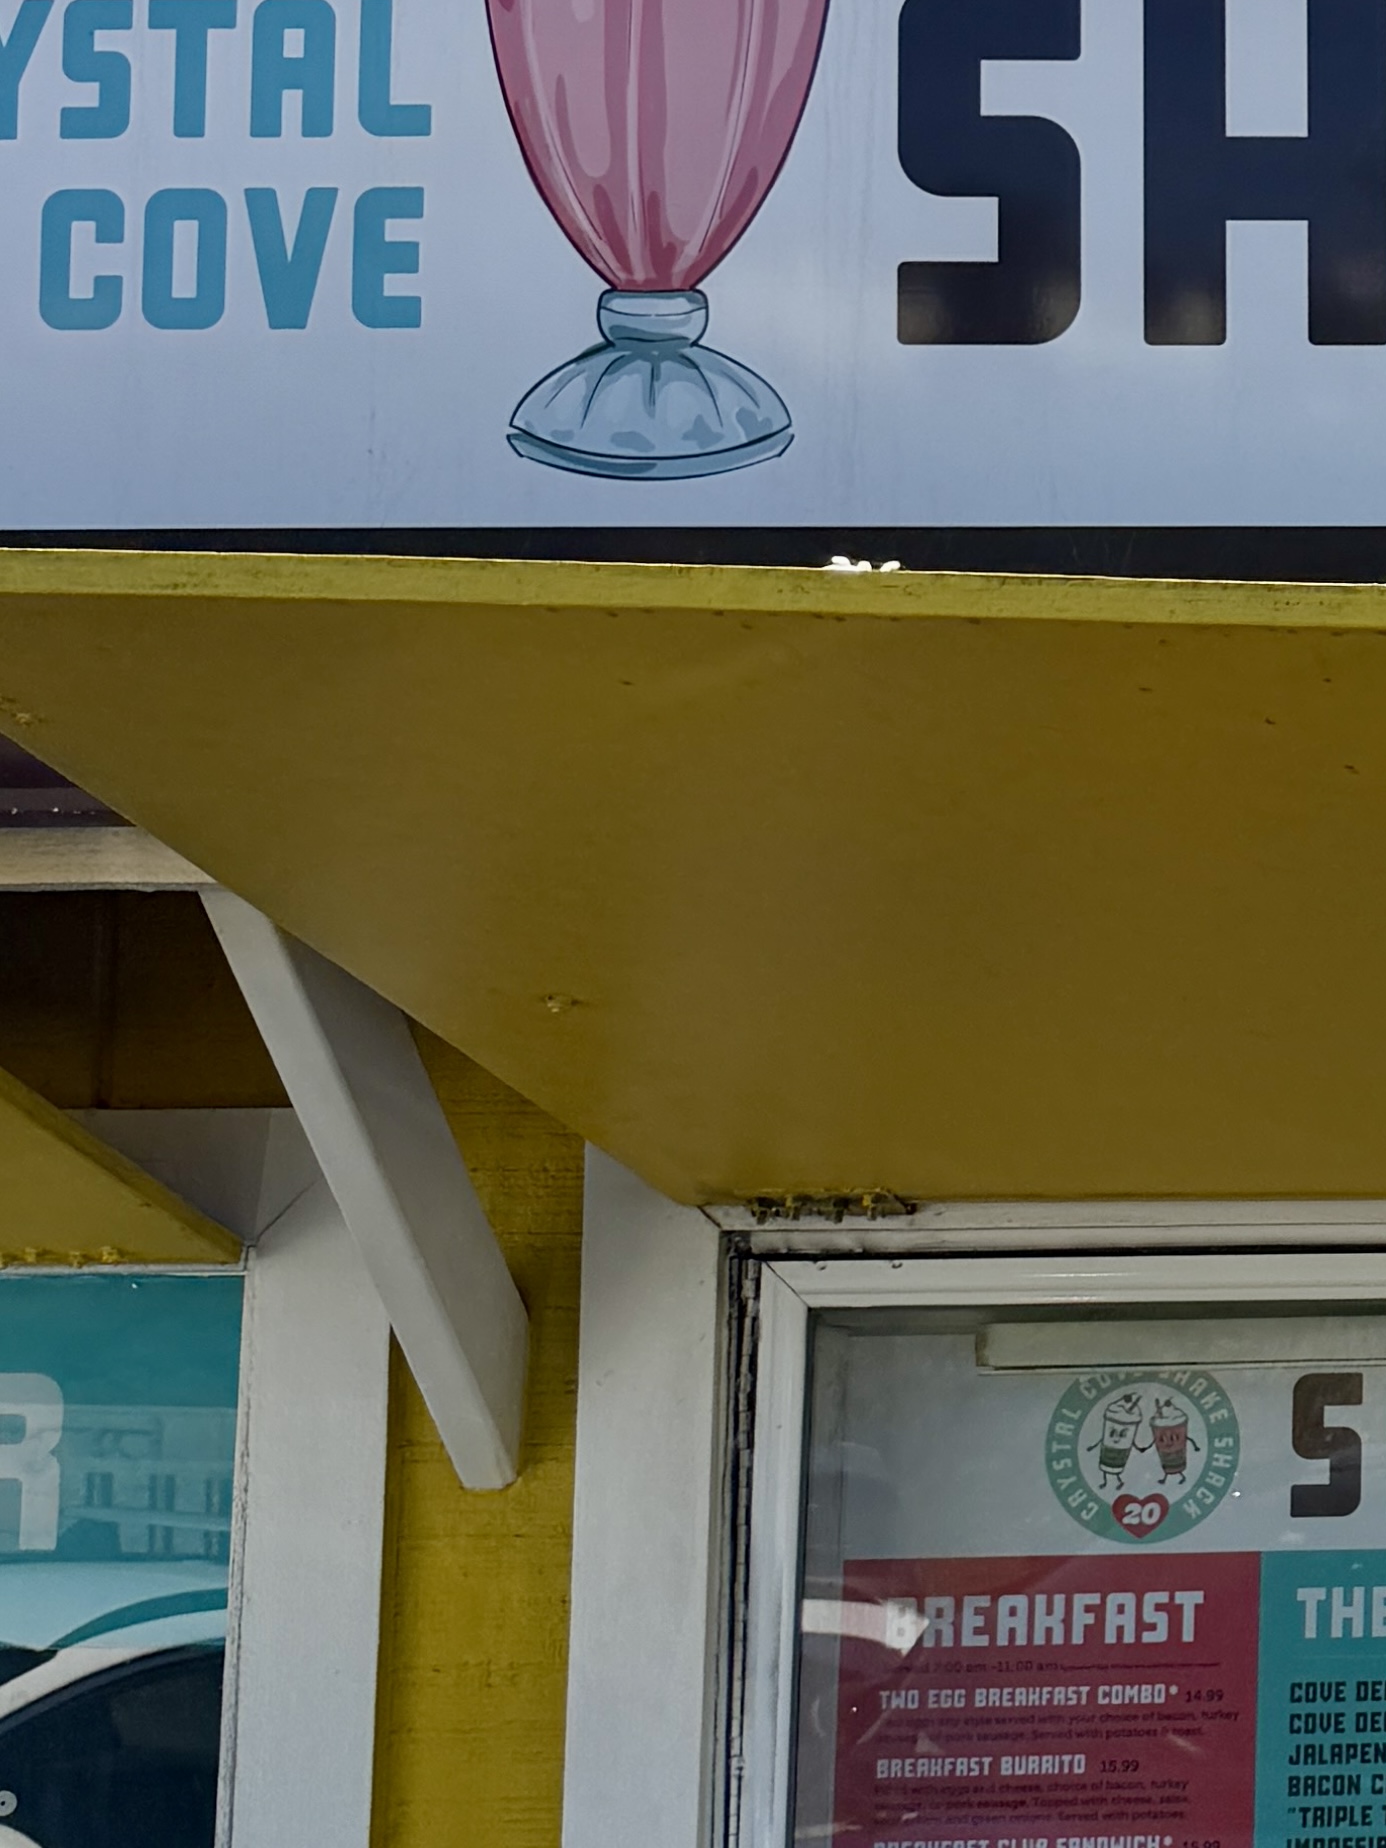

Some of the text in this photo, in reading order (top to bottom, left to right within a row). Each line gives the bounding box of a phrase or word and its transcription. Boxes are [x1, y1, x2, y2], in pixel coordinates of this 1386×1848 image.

[39, 185, 423, 330] COVE
[1053, 1408, 1099, 1521] CRYSTAL
[1183, 1437, 1233, 1518] SHACK
[1122, 1502, 1161, 1525] 20
[879, 1689, 919, 1710] TWO
[928, 1688, 965, 1708] EGG
[975, 1686, 1089, 1708] BREAKFAST
[1185, 1689, 1224, 1703] 14.99
[1290, 1681, 1346, 1703] COVE
[1289, 1712, 1346, 1735] COVE
[877, 1754, 1139, 1779] BREAKFAST BURRITO 15.99
[1288, 1775, 1361, 1797] BACON
